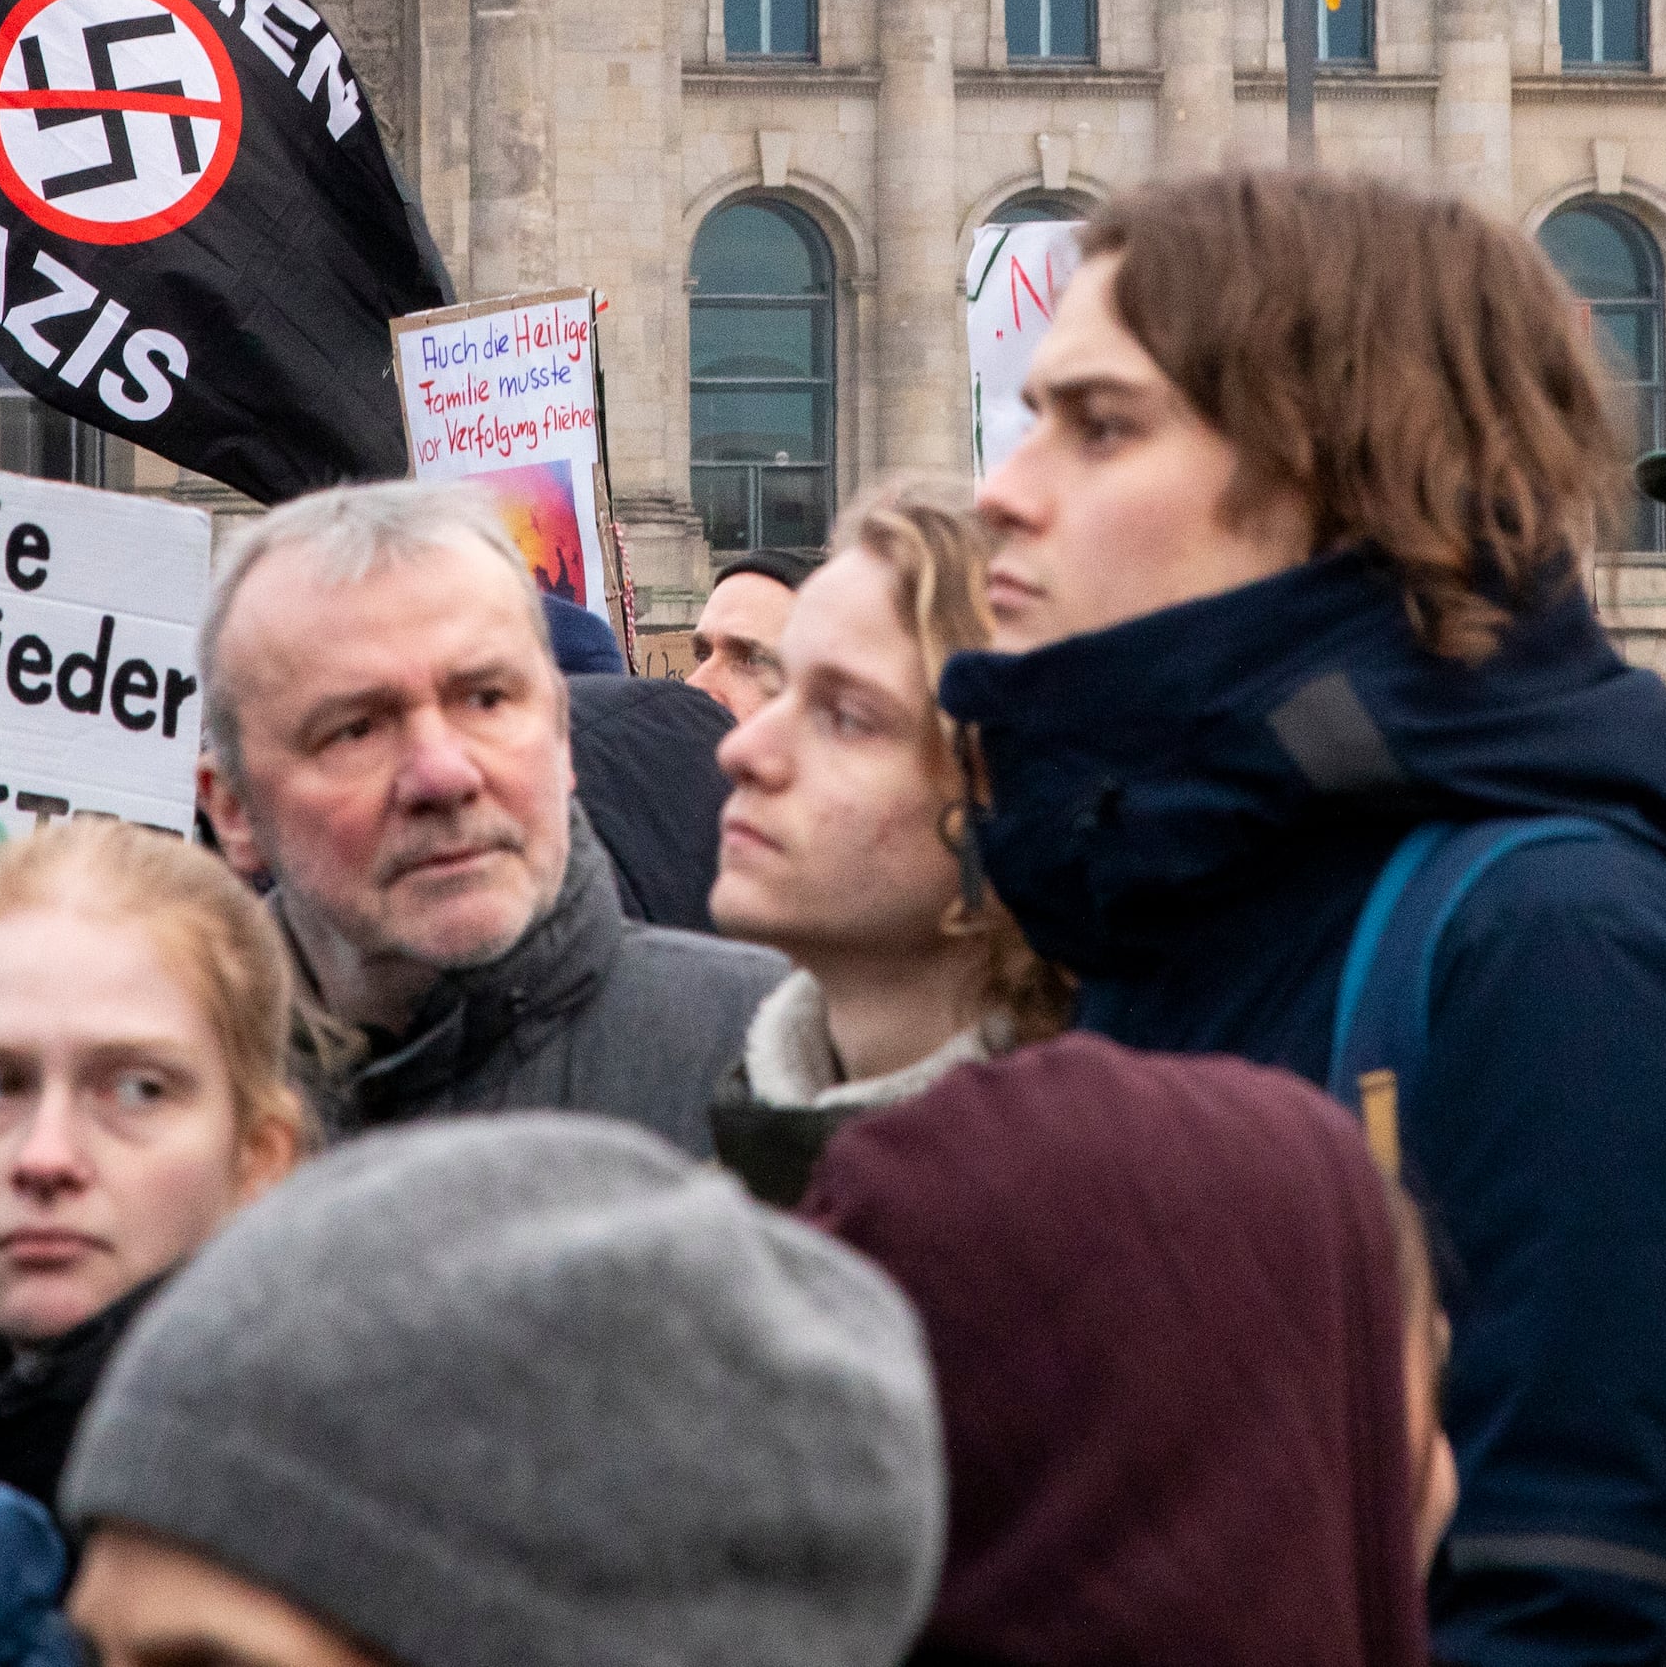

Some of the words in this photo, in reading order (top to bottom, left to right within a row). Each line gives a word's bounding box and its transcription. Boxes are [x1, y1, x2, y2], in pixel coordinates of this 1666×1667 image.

[422, 331, 478, 372] Auch
[483, 322, 510, 360] die
[514, 306, 589, 363] Heilige
[418, 372, 491, 416] Familie
[499, 355, 572, 399] musste
[417, 436, 441, 465] vor
[445, 413, 538, 459] Verfolgung
